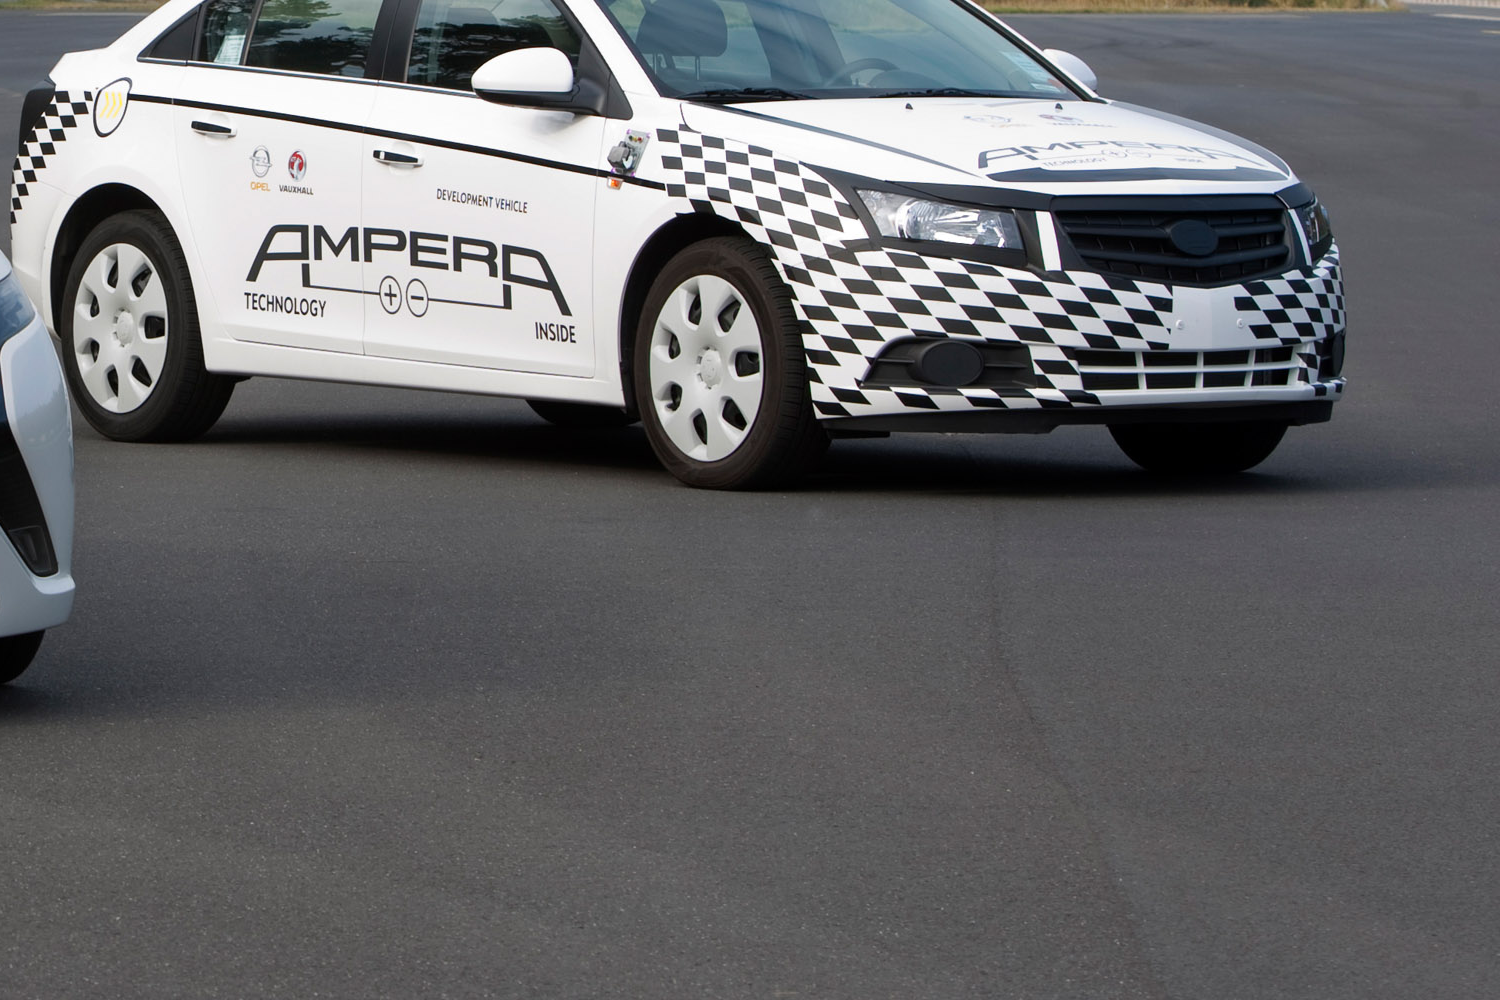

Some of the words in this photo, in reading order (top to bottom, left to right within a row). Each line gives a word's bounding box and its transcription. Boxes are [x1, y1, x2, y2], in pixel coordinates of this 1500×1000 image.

[250, 181, 271, 192] OPEL
[279, 184, 314, 196] VAUXHALL
[436, 188, 494, 208] DEVELOPMENT
[495, 197, 528, 214] VEHICLE
[246, 224, 573, 317] AMPERA
[244, 291, 327, 318] TECHNOLOGY
[534, 321, 577, 344] INSIDE
